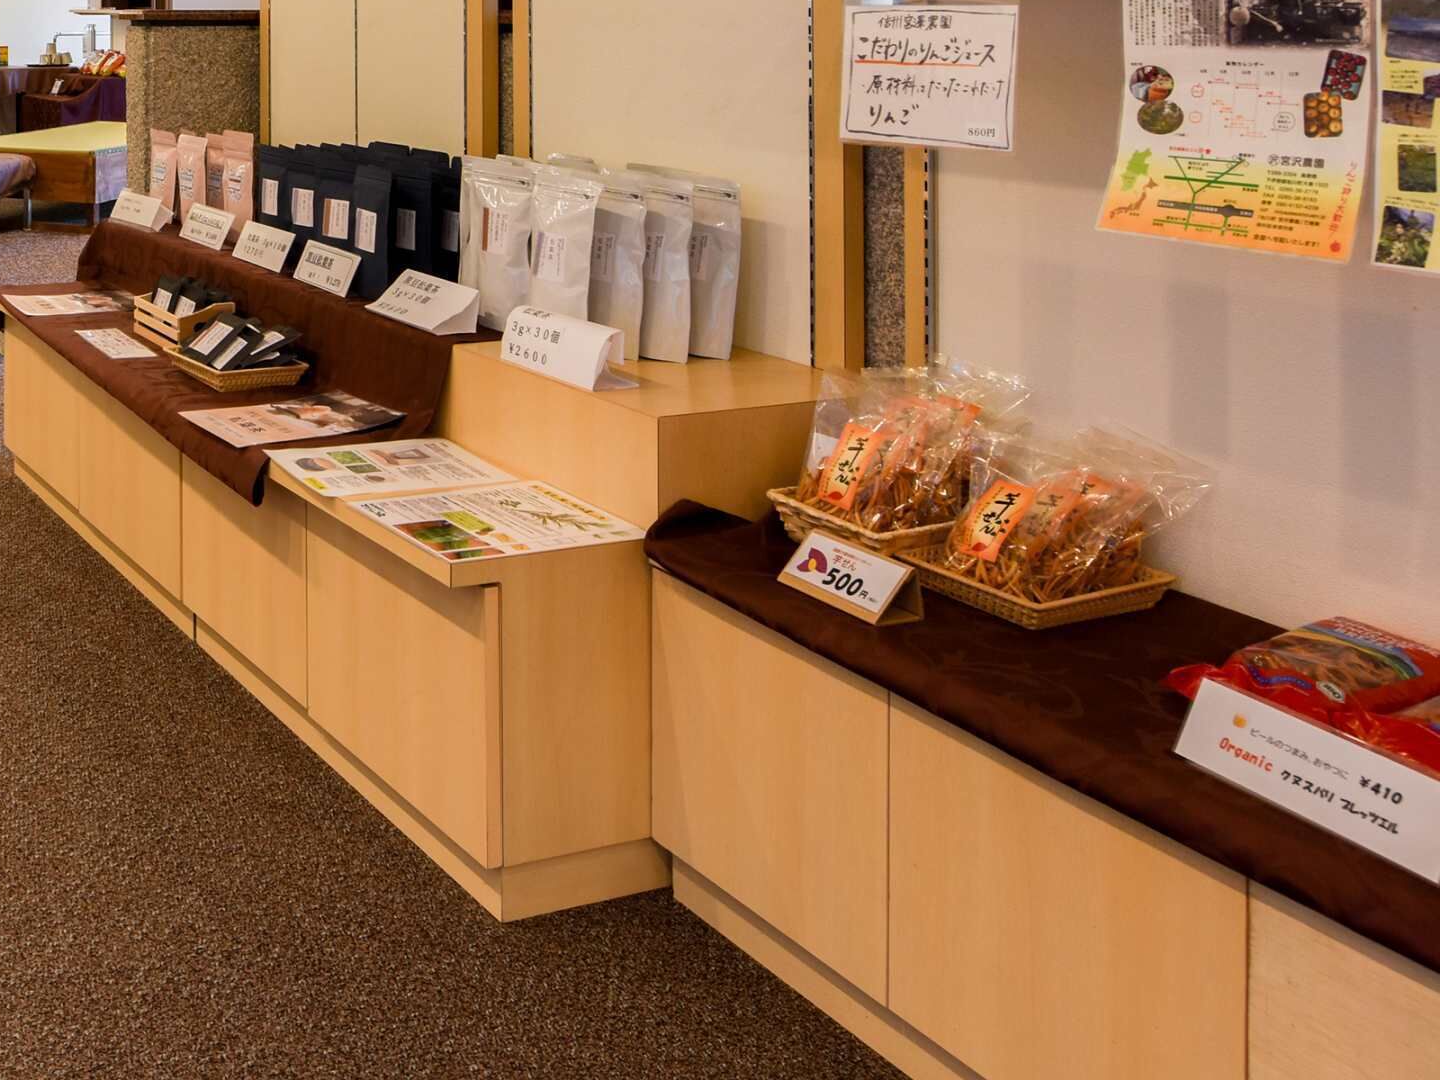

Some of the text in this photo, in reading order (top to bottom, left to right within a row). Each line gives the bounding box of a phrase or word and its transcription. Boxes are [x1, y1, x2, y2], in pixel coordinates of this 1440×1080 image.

[869, 103, 920, 127] りんご
[511, 320, 561, 345] 3g×30個
[508, 341, 548, 366] ¥2600
[821, 567, 869, 600] 500円
[1219, 736, 1274, 773] Organic
[1358, 775, 1404, 806] ¥410
